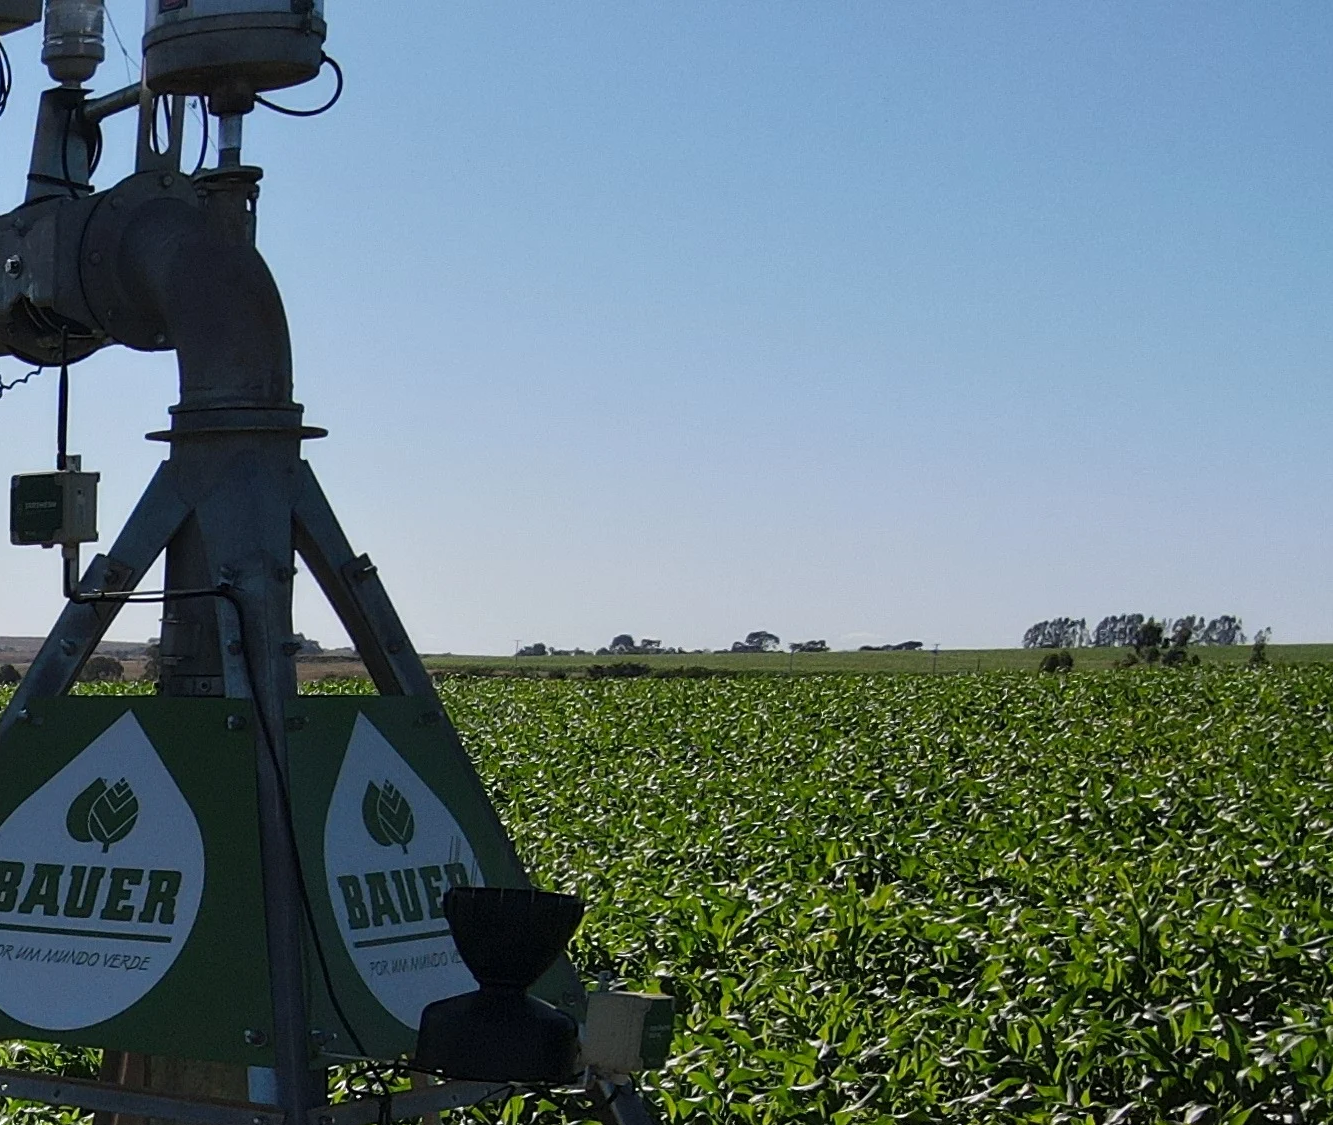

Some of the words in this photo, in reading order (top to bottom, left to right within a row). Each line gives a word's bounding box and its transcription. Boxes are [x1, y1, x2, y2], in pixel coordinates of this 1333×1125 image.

[15, 946, 40, 962] UM
[41, 948, 100, 967] MUNDO
[103, 953, 151, 971] VERDE
[369, 960, 391, 977] POR
